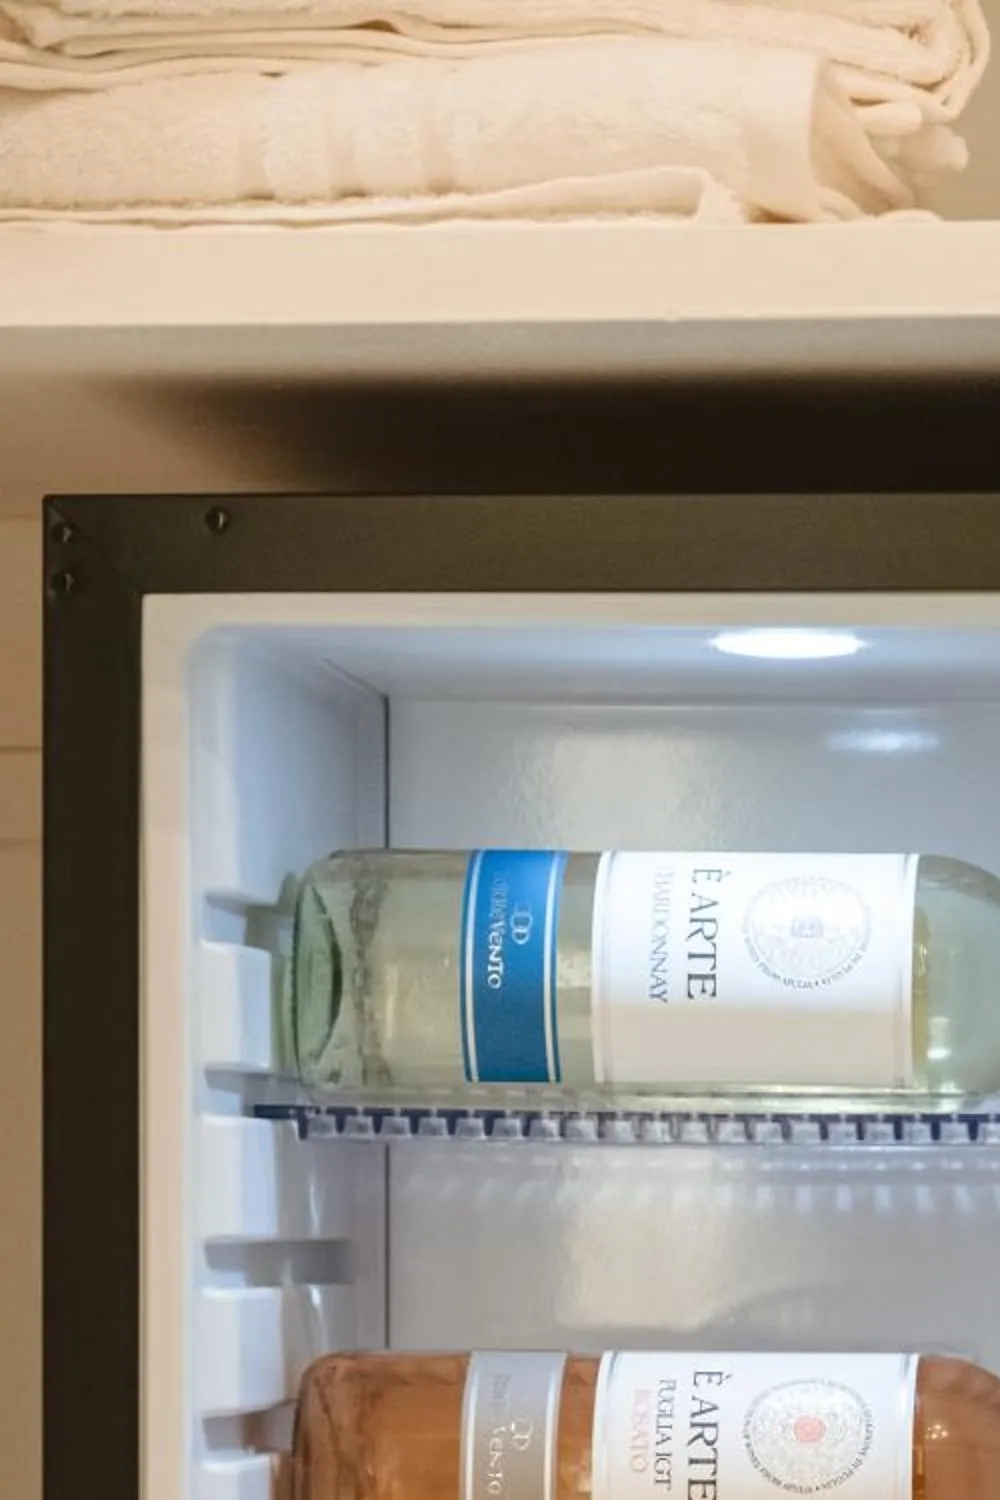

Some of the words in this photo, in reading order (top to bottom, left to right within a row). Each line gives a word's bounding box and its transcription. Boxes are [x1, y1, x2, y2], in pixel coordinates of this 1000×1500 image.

[648, 865, 674, 1004] CHARDONNAY
[686, 891, 719, 1001] ARTE
[654, 1378, 677, 1446] PUGLIA
[693, 1371, 730, 1386] È
[628, 1387, 652, 1474] ROSATO
[653, 1451, 675, 1492] IGT
